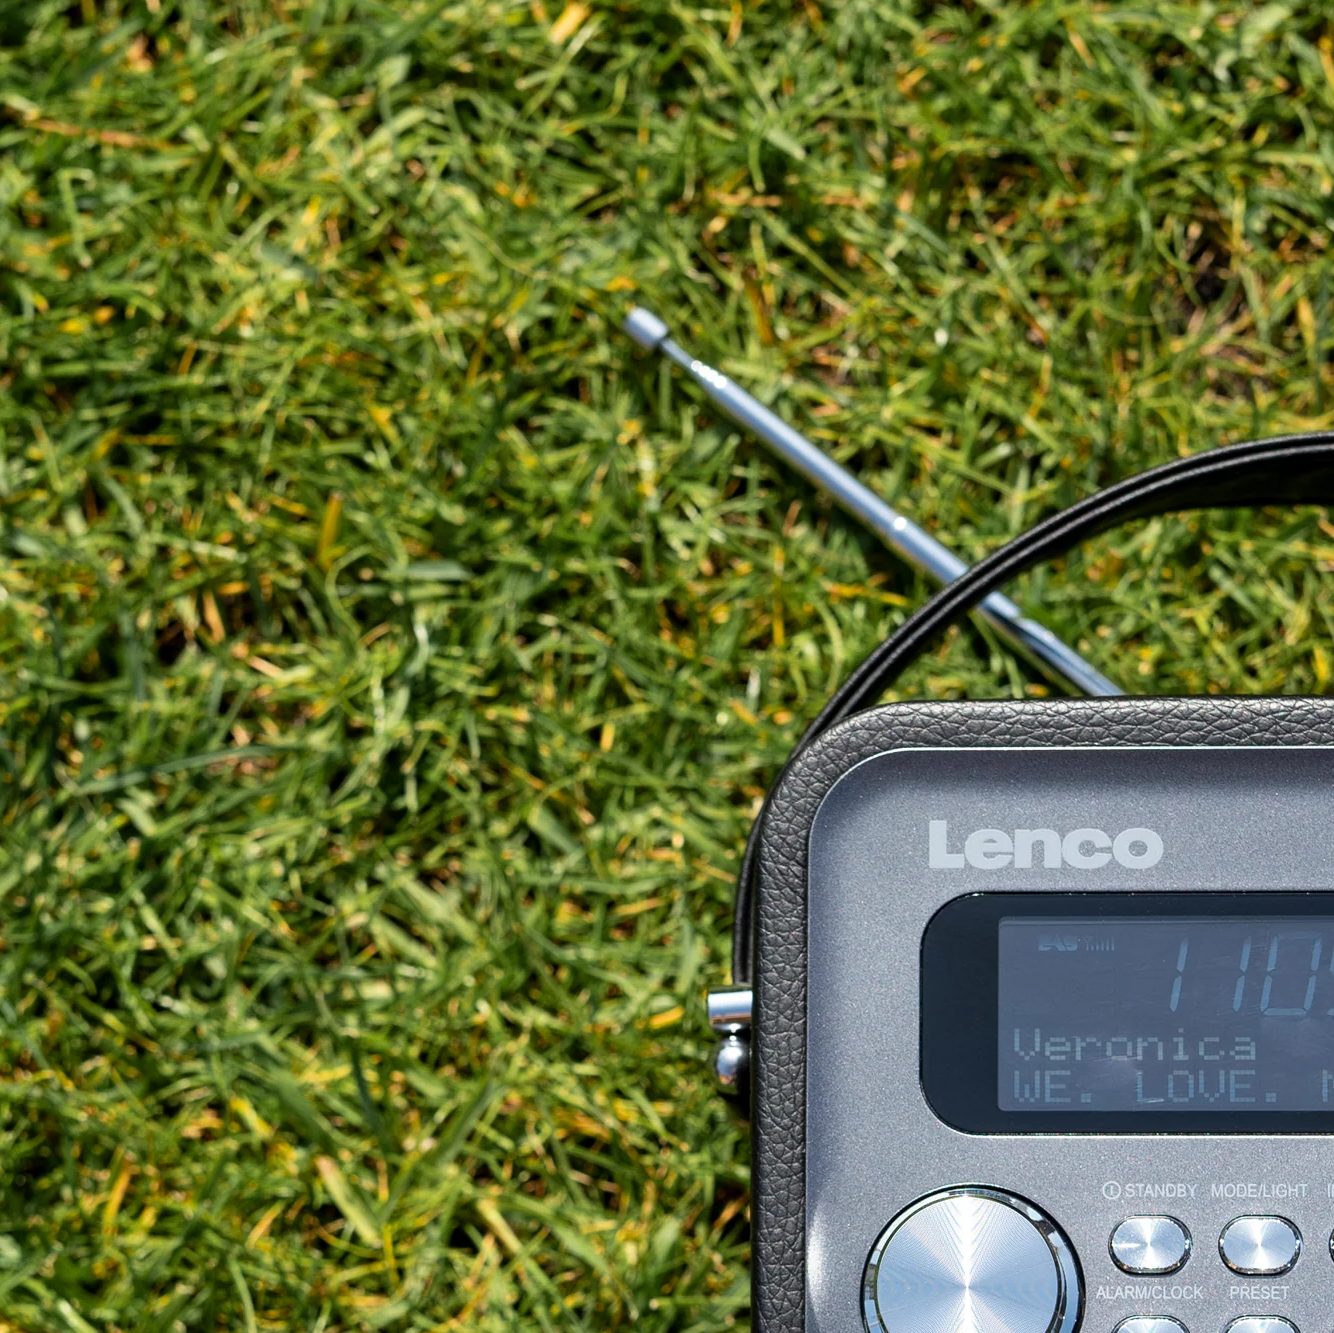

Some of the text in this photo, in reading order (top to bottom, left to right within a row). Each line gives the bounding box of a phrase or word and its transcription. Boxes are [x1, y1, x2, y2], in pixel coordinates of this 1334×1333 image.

[928, 820, 1164, 869] Lenco
[1014, 1028, 1256, 1060] Veronica
[1014, 1070, 1092, 1103] WE.
[1136, 1070, 1277, 1103] LOVE.
[1125, 1183, 1198, 1198] STANDBY
[1211, 1183, 1308, 1198] MODE/LIGHT
[1095, 1285, 1204, 1300] ALARM/CLOCK
[1230, 1285, 1290, 1300] PRESET
